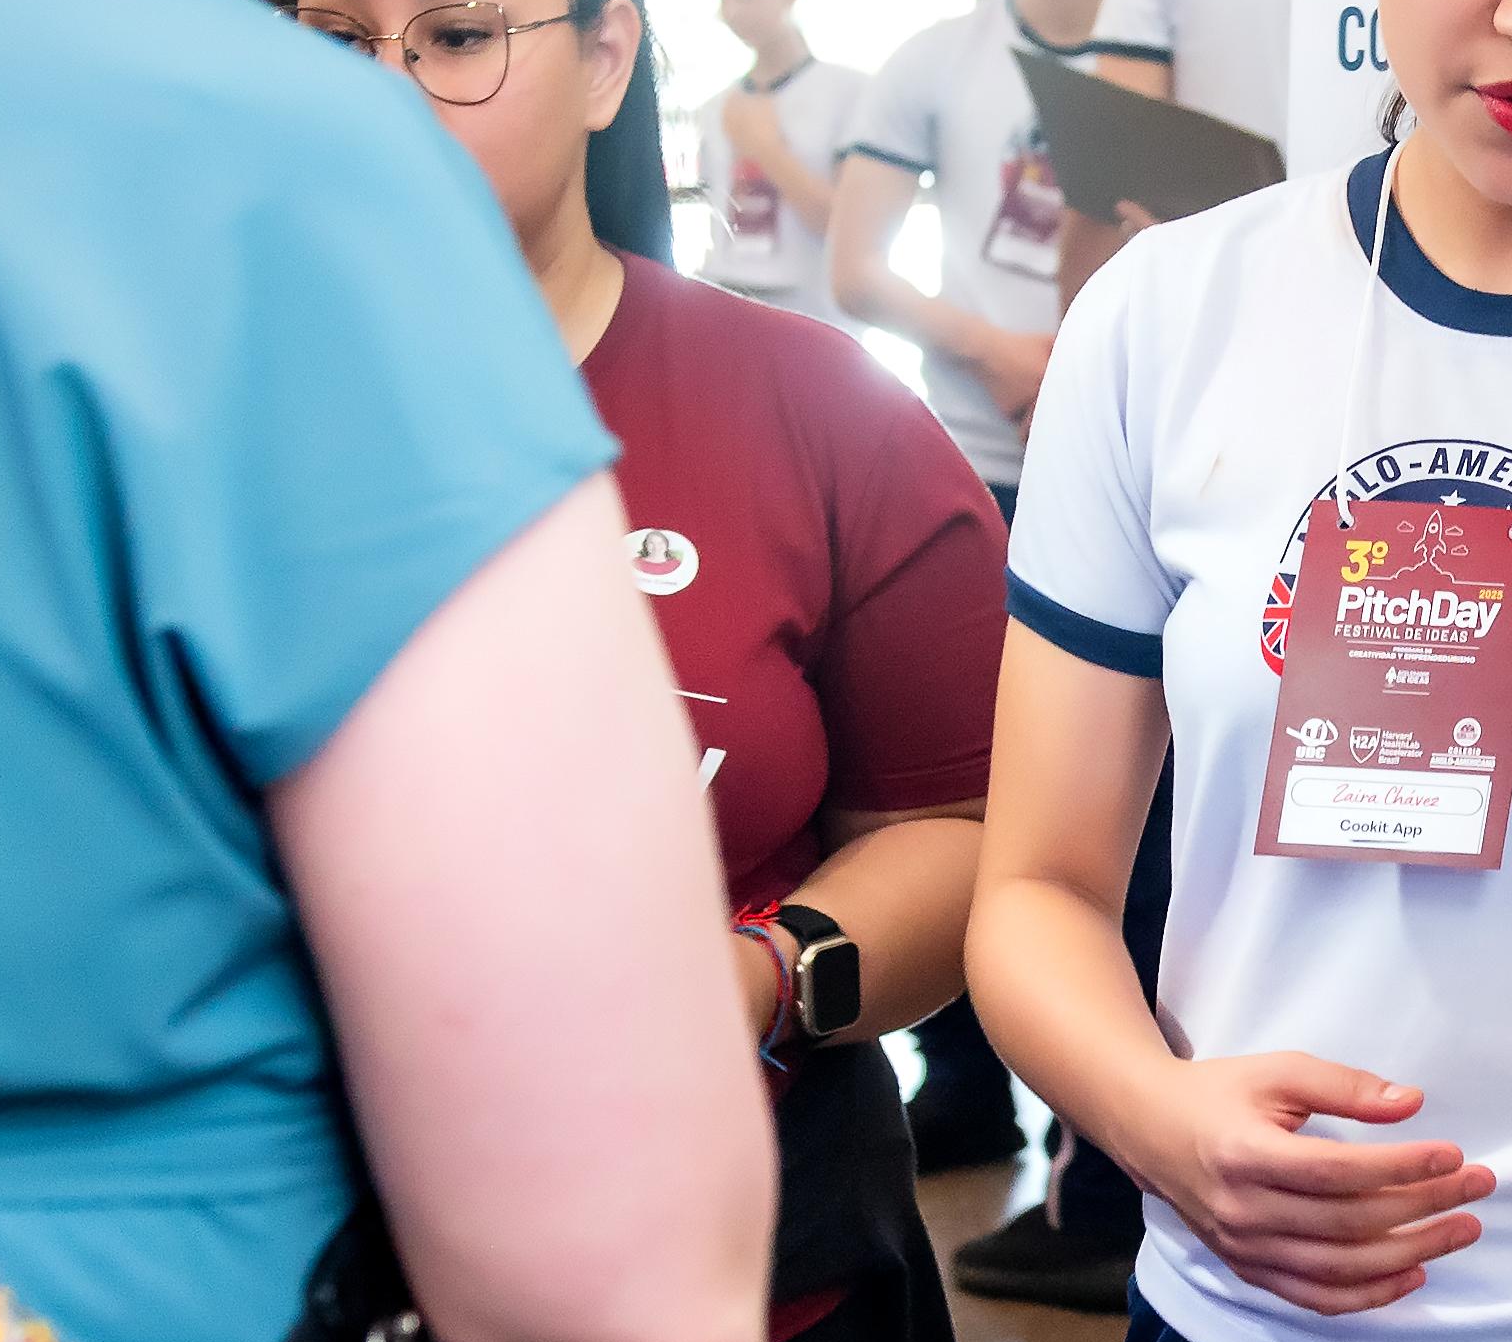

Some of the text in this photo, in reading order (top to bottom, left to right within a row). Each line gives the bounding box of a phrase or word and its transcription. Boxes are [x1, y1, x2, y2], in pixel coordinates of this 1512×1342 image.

[1336, 585, 1502, 639] PitchDay
[1334, 624, 1469, 644] FESTIVAL DE IDEAS
[1332, 782, 1378, 804] Zaira
[1340, 819, 1423, 838] Cookit App
